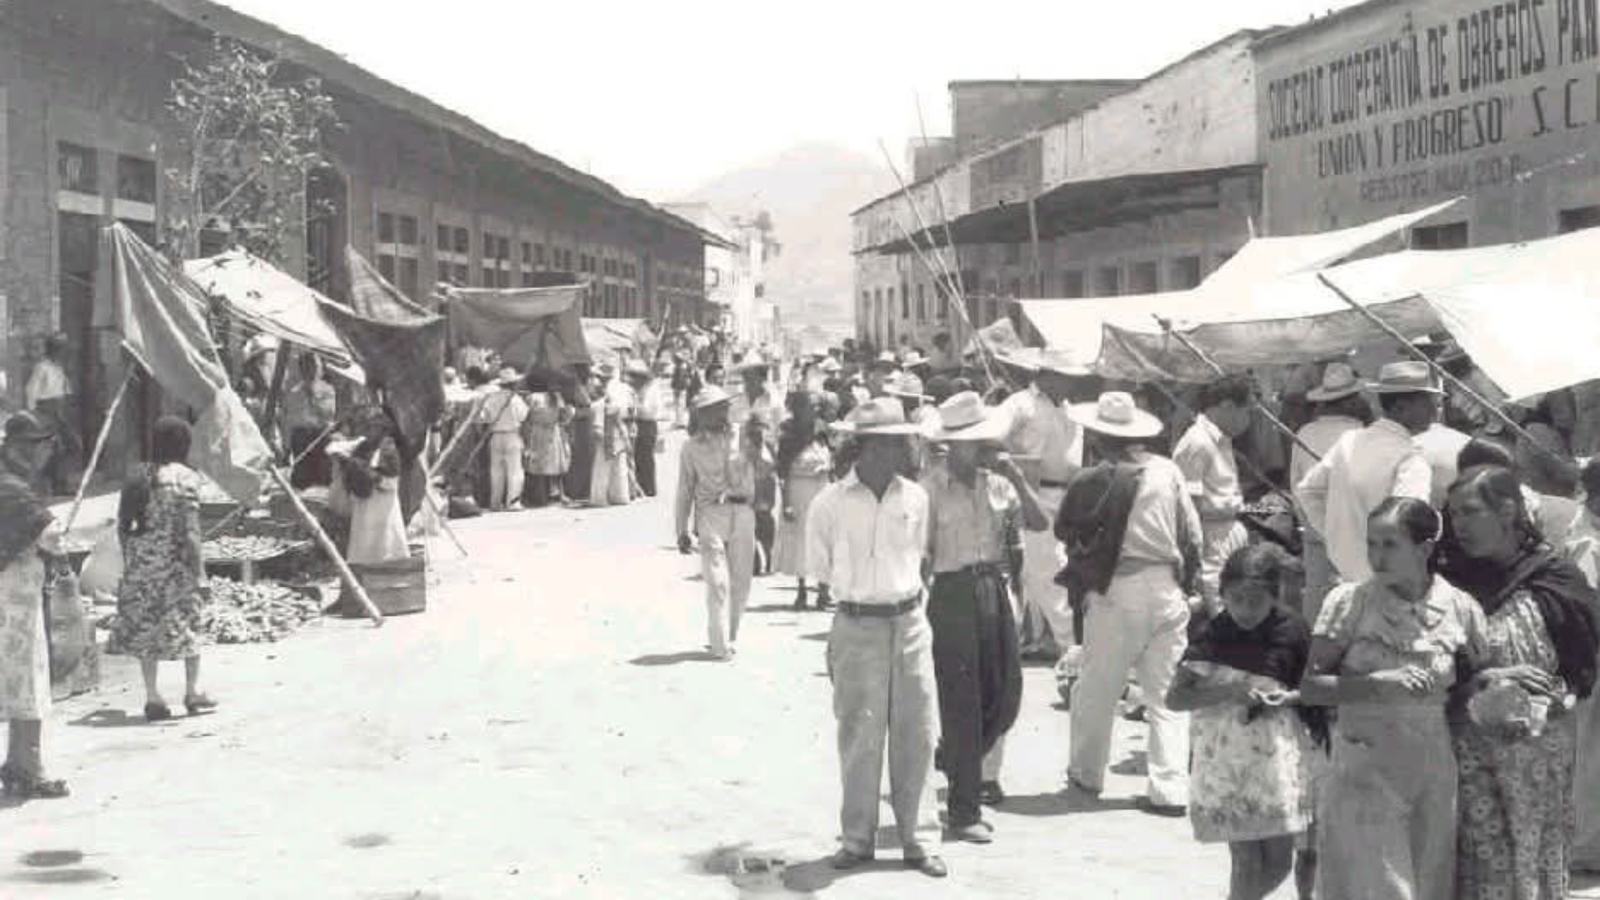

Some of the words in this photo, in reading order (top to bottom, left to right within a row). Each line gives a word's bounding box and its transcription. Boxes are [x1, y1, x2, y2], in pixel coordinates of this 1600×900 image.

[1269, 65, 1324, 141] SOCIEDAD
[1328, 35, 1421, 125] COOPERATIVA
[1427, 24, 1450, 98] DE
[1457, 0, 1546, 93] OBREROS
[1318, 127, 1367, 178] UNION
[1373, 123, 1384, 169] Y
